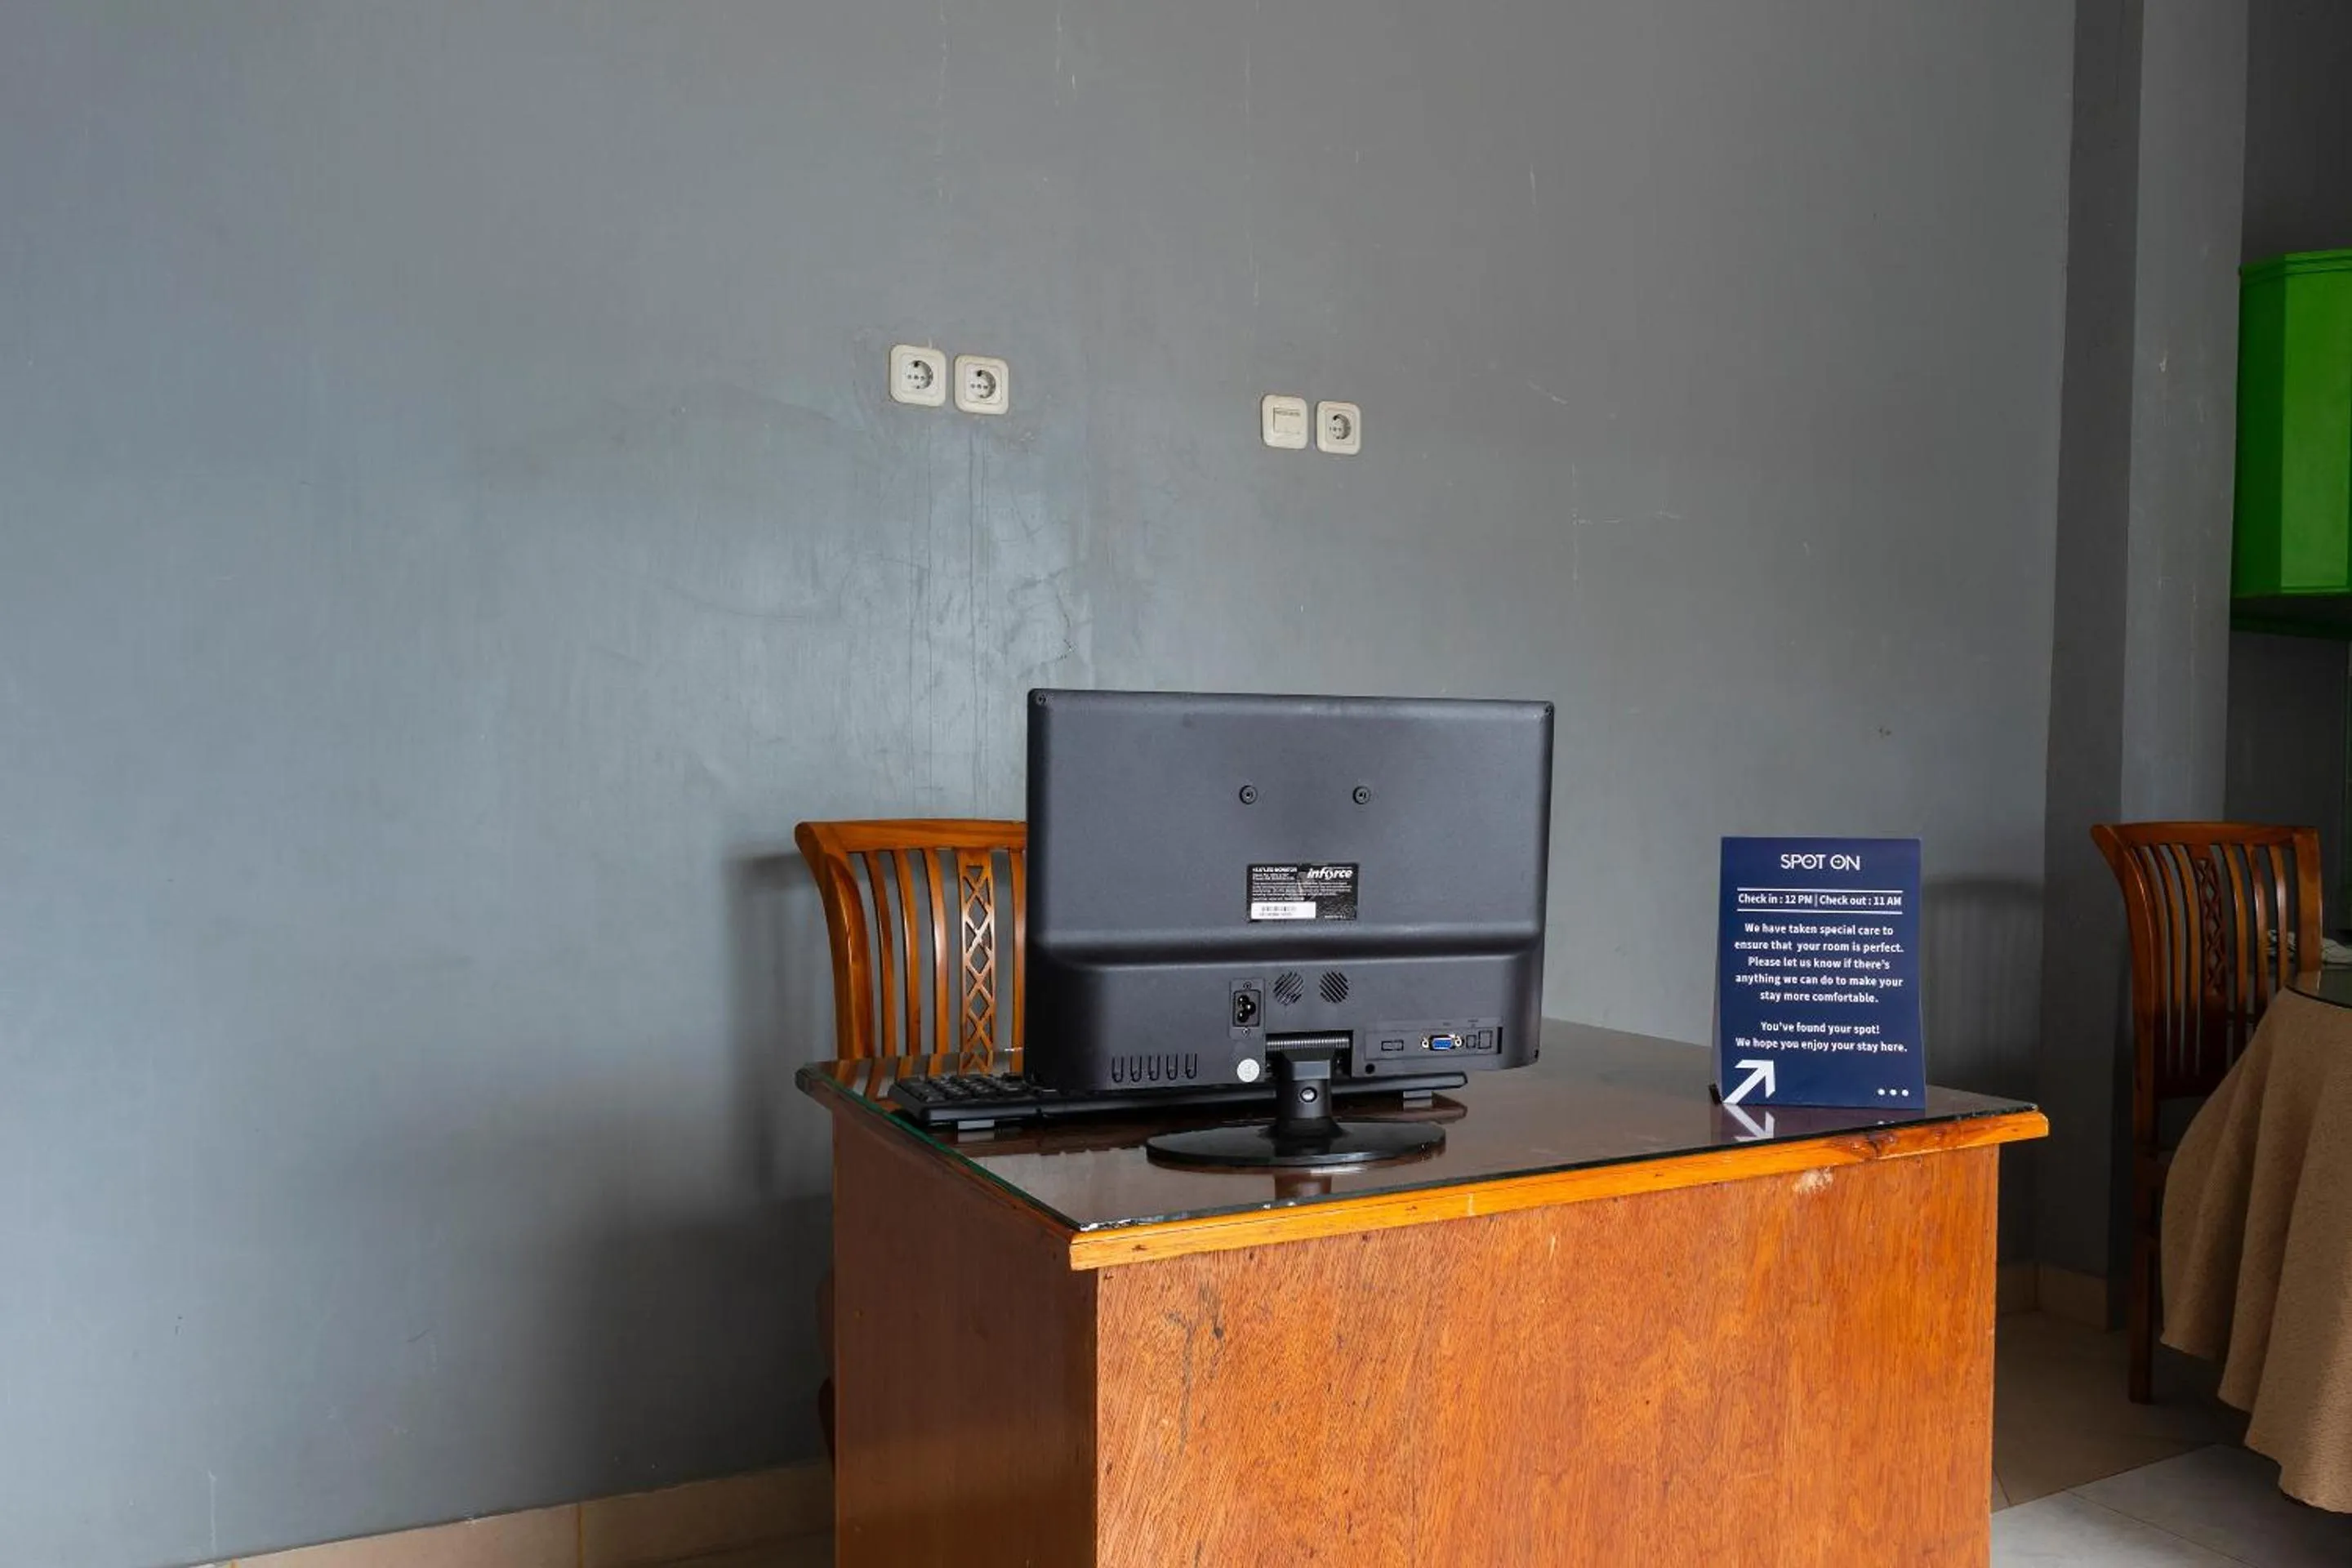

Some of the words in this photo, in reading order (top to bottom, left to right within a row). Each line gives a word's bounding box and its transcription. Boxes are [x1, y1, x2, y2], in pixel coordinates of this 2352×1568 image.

[1780, 853, 1826, 870] SPOT
[1829, 853, 1861, 871] ON
[1307, 866, 1353, 880] inforce
[1738, 893, 1767, 904] Check
[1784, 894, 1797, 905] 12
[1797, 894, 1813, 905] PM
[1819, 894, 1849, 906] Check
[1849, 896, 1868, 906] out
[1873, 896, 1886, 906] 11
[1886, 896, 1902, 906] AM
[1744, 923, 1761, 933] We
[1762, 923, 1787, 934] have
[1788, 923, 1818, 934] taken
[1819, 924, 1856, 937] special
[1857, 927, 1882, 936] care
[1882, 925, 1894, 936] to
[1734, 942, 1770, 950] ensure
[1770, 940, 1793, 951] that
[1796, 942, 1821, 953] your
[1822, 942, 1850, 952] room
[1851, 940, 1861, 952] is
[1862, 941, 1904, 955] perfect.
[1748, 956, 1782, 967] Please
[1783, 956, 1798, 968] let
[1799, 959, 1812, 969] us
[1813, 957, 1842, 969] know
[1843, 957, 1852, 969] if
[1852, 958, 1891, 970] there's
[1735, 973, 1782, 987] anything
[1782, 976, 1798, 984] we
[1799, 976, 1819, 985] can
[1820, 974, 1834, 986] do
[1835, 975, 1847, 986] to
[1848, 975, 1878, 987] make
[1878, 978, 1904, 989] your
[1760, 991, 1782, 1003] stay
[1783, 991, 1811, 1001] more
[1811, 991, 1879, 1004] comfortable.
[1760, 1021, 1795, 1033] You've
[1796, 1021, 1827, 1033] found
[1827, 1024, 1853, 1036] your
[1853, 1024, 1881, 1036] spot!
[1735, 1036, 1751, 1048] We
[1752, 1037, 1779, 1050] hope
[1780, 1040, 1800, 1051] you
[1801, 1038, 1829, 1052] enjoy
[1830, 1041, 1855, 1053] your
[1855, 1041, 1879, 1054] stay
[1880, 1040, 1908, 1053] here.
